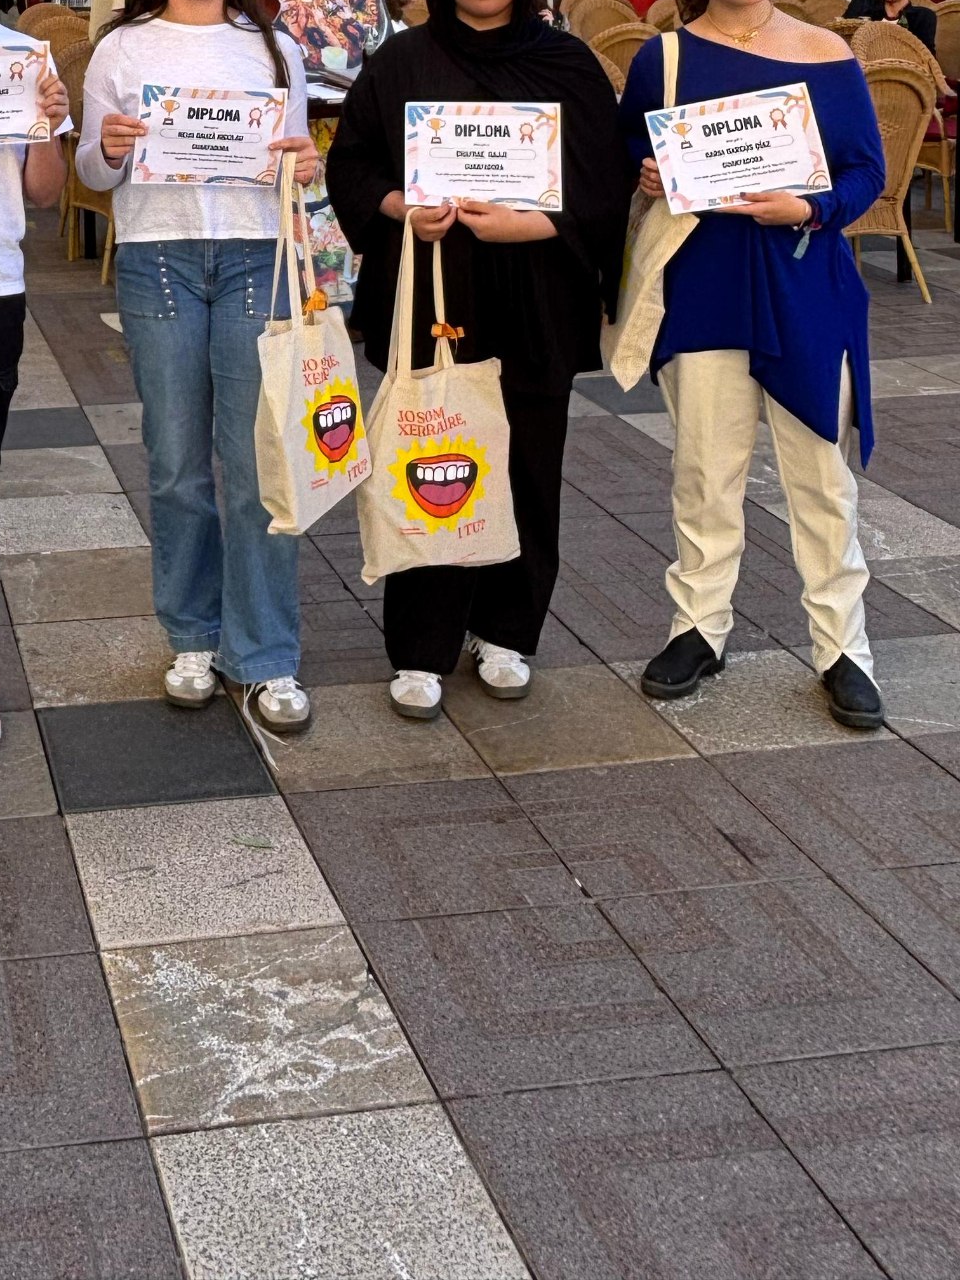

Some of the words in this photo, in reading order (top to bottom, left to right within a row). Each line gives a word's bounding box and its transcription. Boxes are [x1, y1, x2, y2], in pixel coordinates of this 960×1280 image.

[187, 107, 241, 122] DIPLOMA
[455, 124, 511, 138] DIPLOMA
[702, 115, 762, 137] DIPLOMA
[302, 358, 318, 372] JO
[397, 410, 415, 422] JO
[416, 406, 444, 424] SOM
